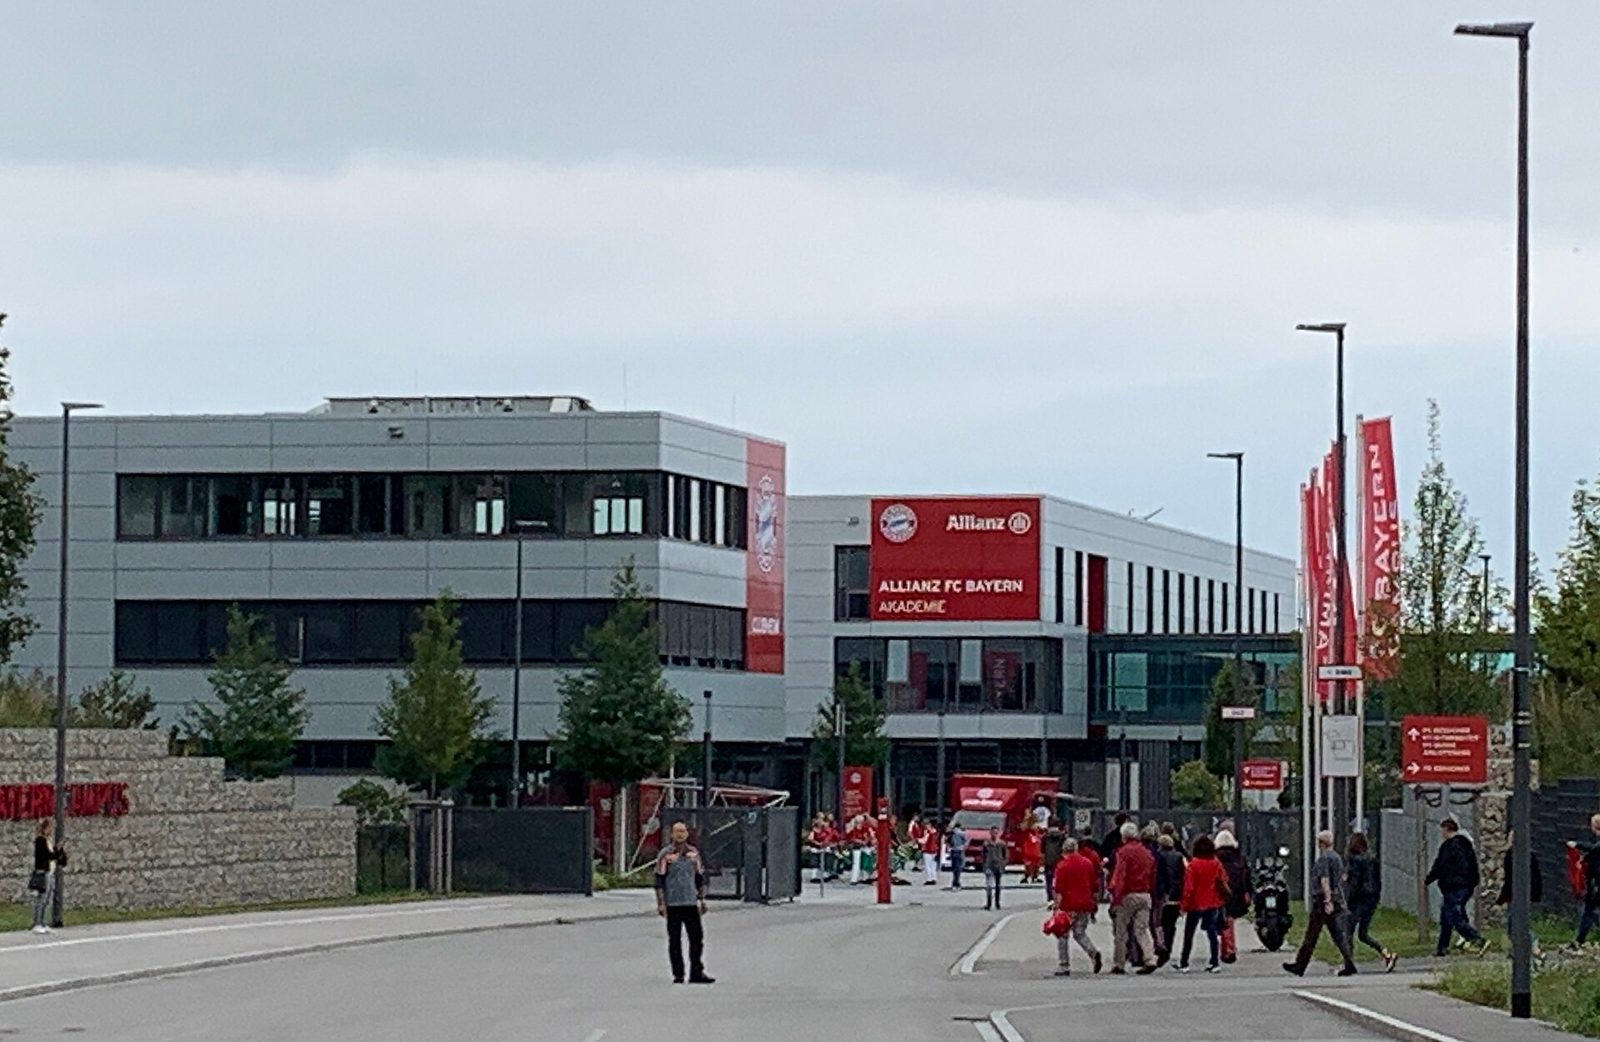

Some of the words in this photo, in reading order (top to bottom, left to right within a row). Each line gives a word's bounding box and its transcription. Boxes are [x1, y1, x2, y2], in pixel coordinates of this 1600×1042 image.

[946, 513, 1005, 531] Allianz
[1368, 444, 1391, 600] BAYERN
[878, 580, 941, 593] ALLIANZ
[944, 580, 963, 593] FC
[965, 580, 1023, 593] BAYERN
[878, 600, 946, 614] AKADEMIE
